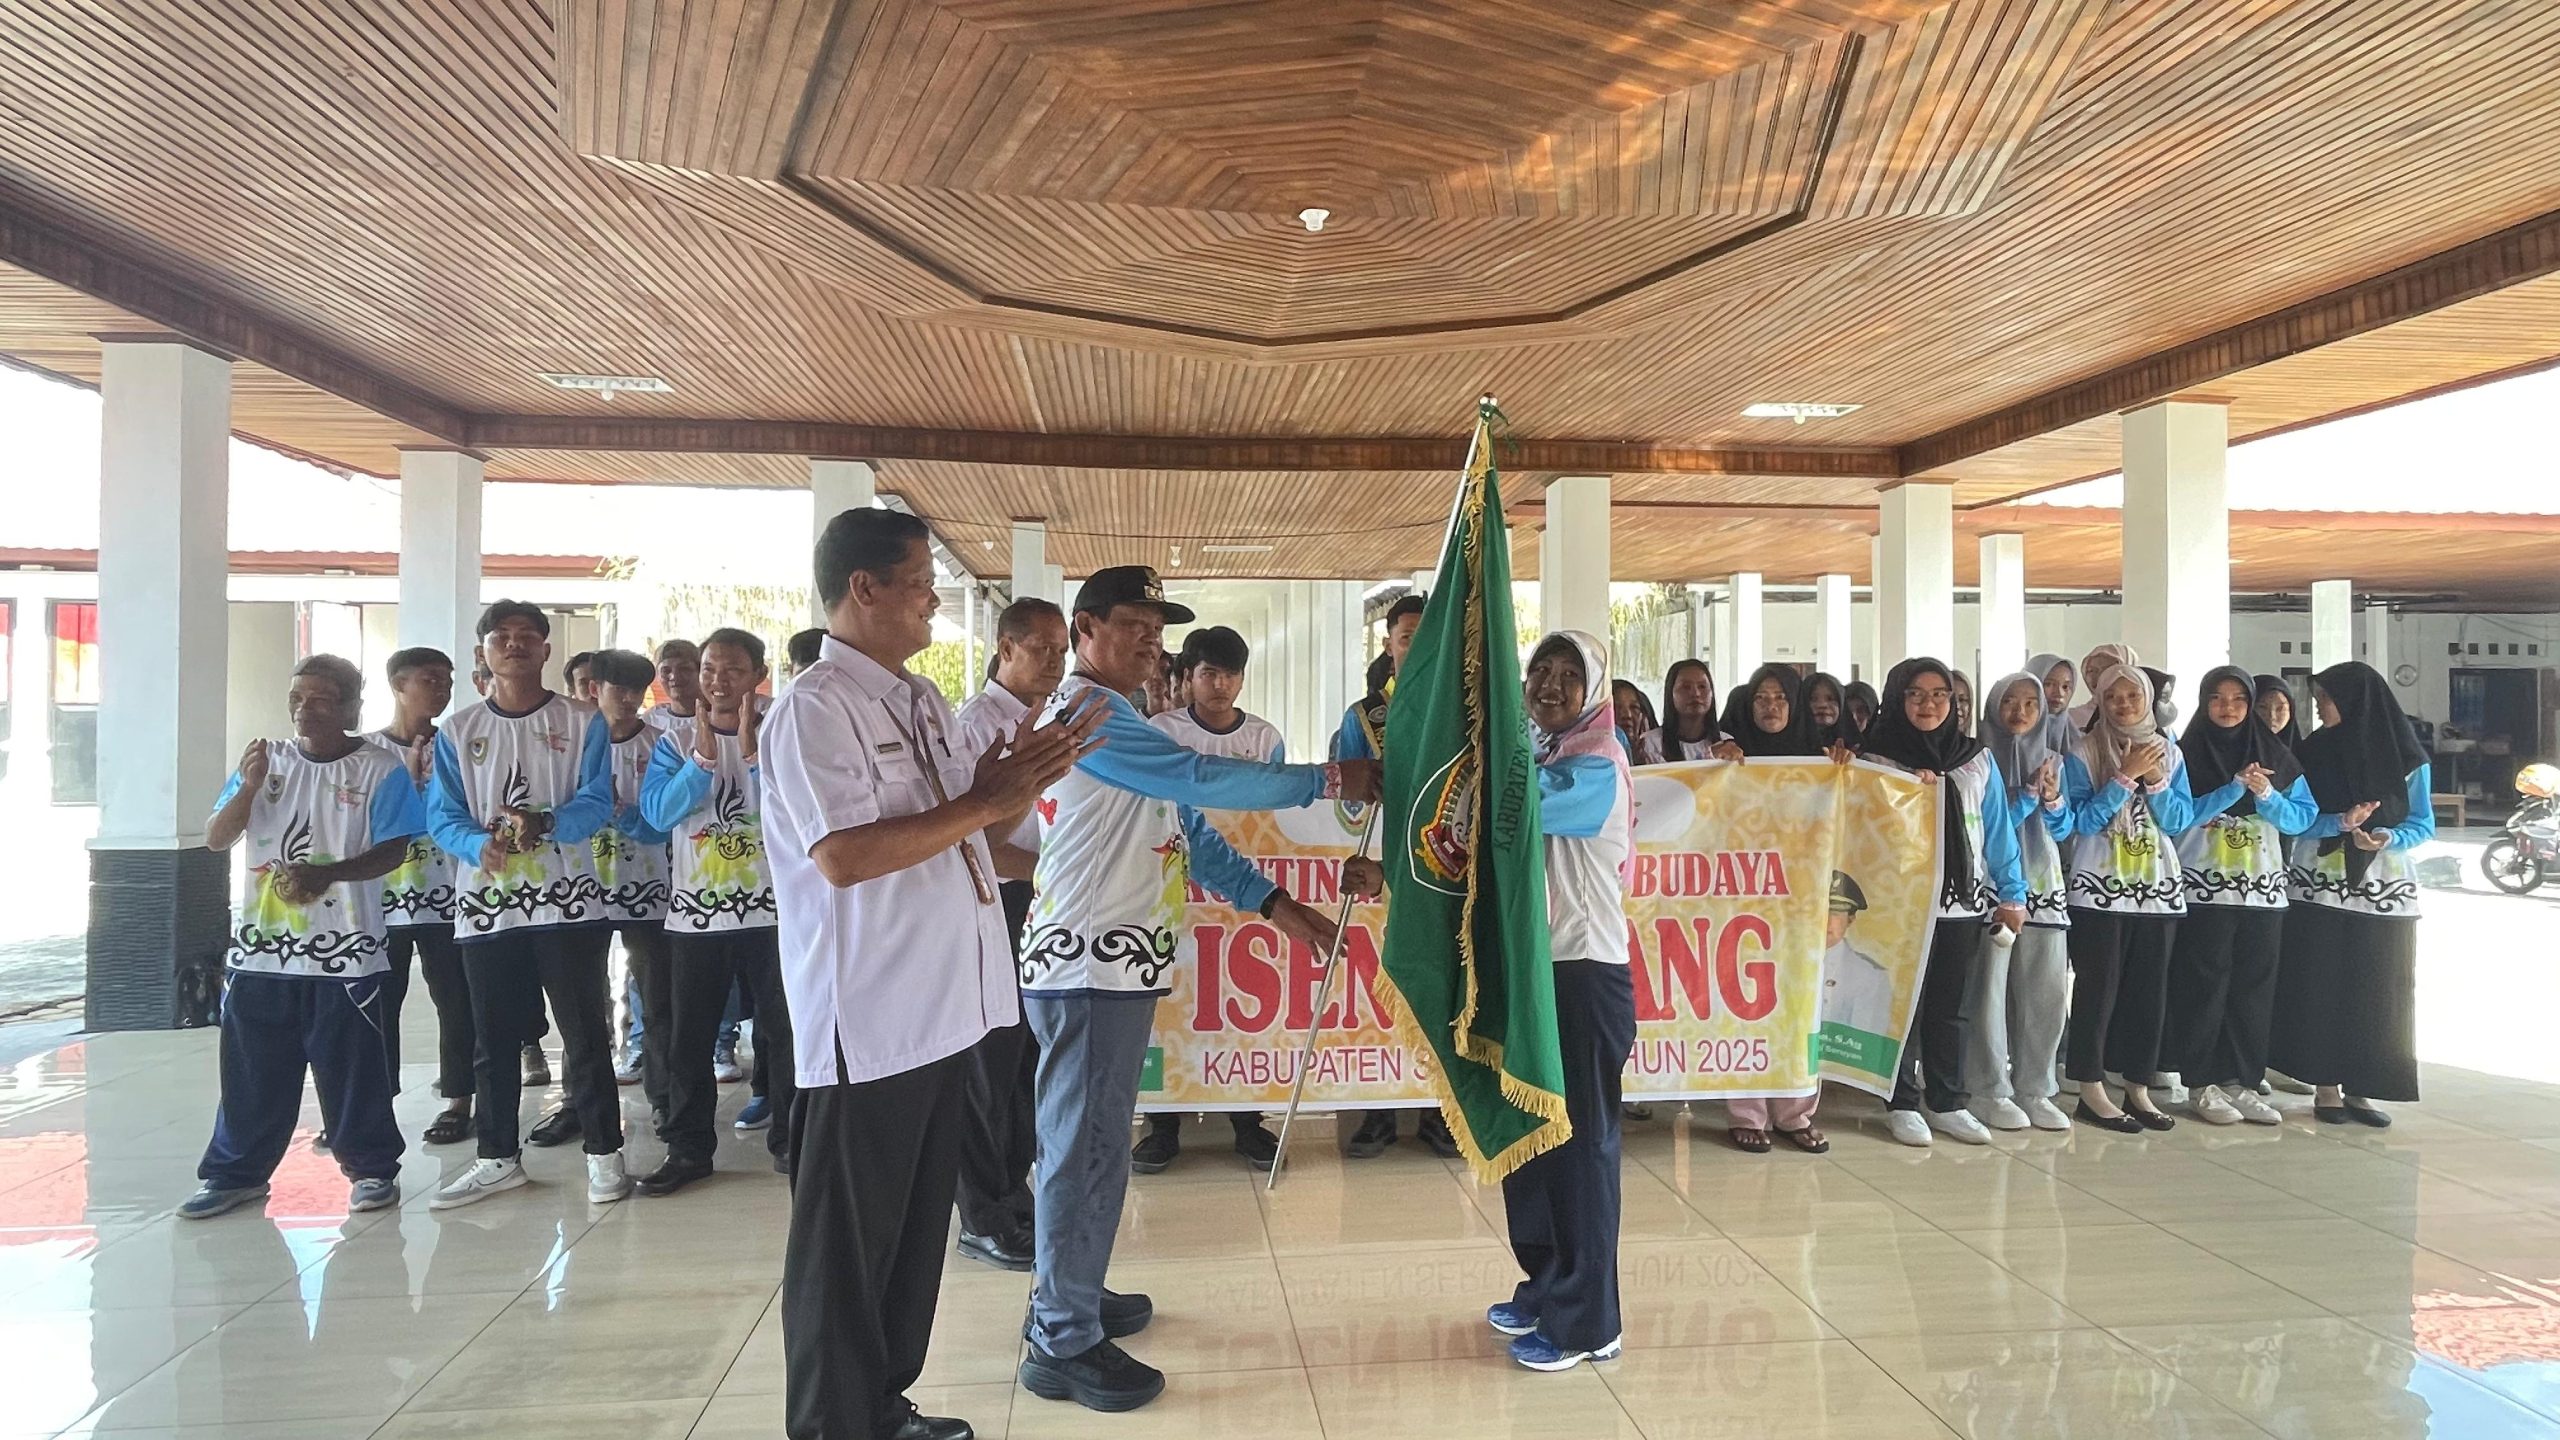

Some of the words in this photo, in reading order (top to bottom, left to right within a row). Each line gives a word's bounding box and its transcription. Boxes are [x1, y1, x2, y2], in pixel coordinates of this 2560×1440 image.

[1493, 747, 1530, 852] KABUPATEN
[1631, 852, 1790, 898] BUDAYA
[1626, 915, 1777, 1021] ANG
[1204, 1047, 1401, 1084] KABUPATEN
[1629, 1040, 1686, 1074] HUN
[1697, 1039, 1769, 1073] 2025
